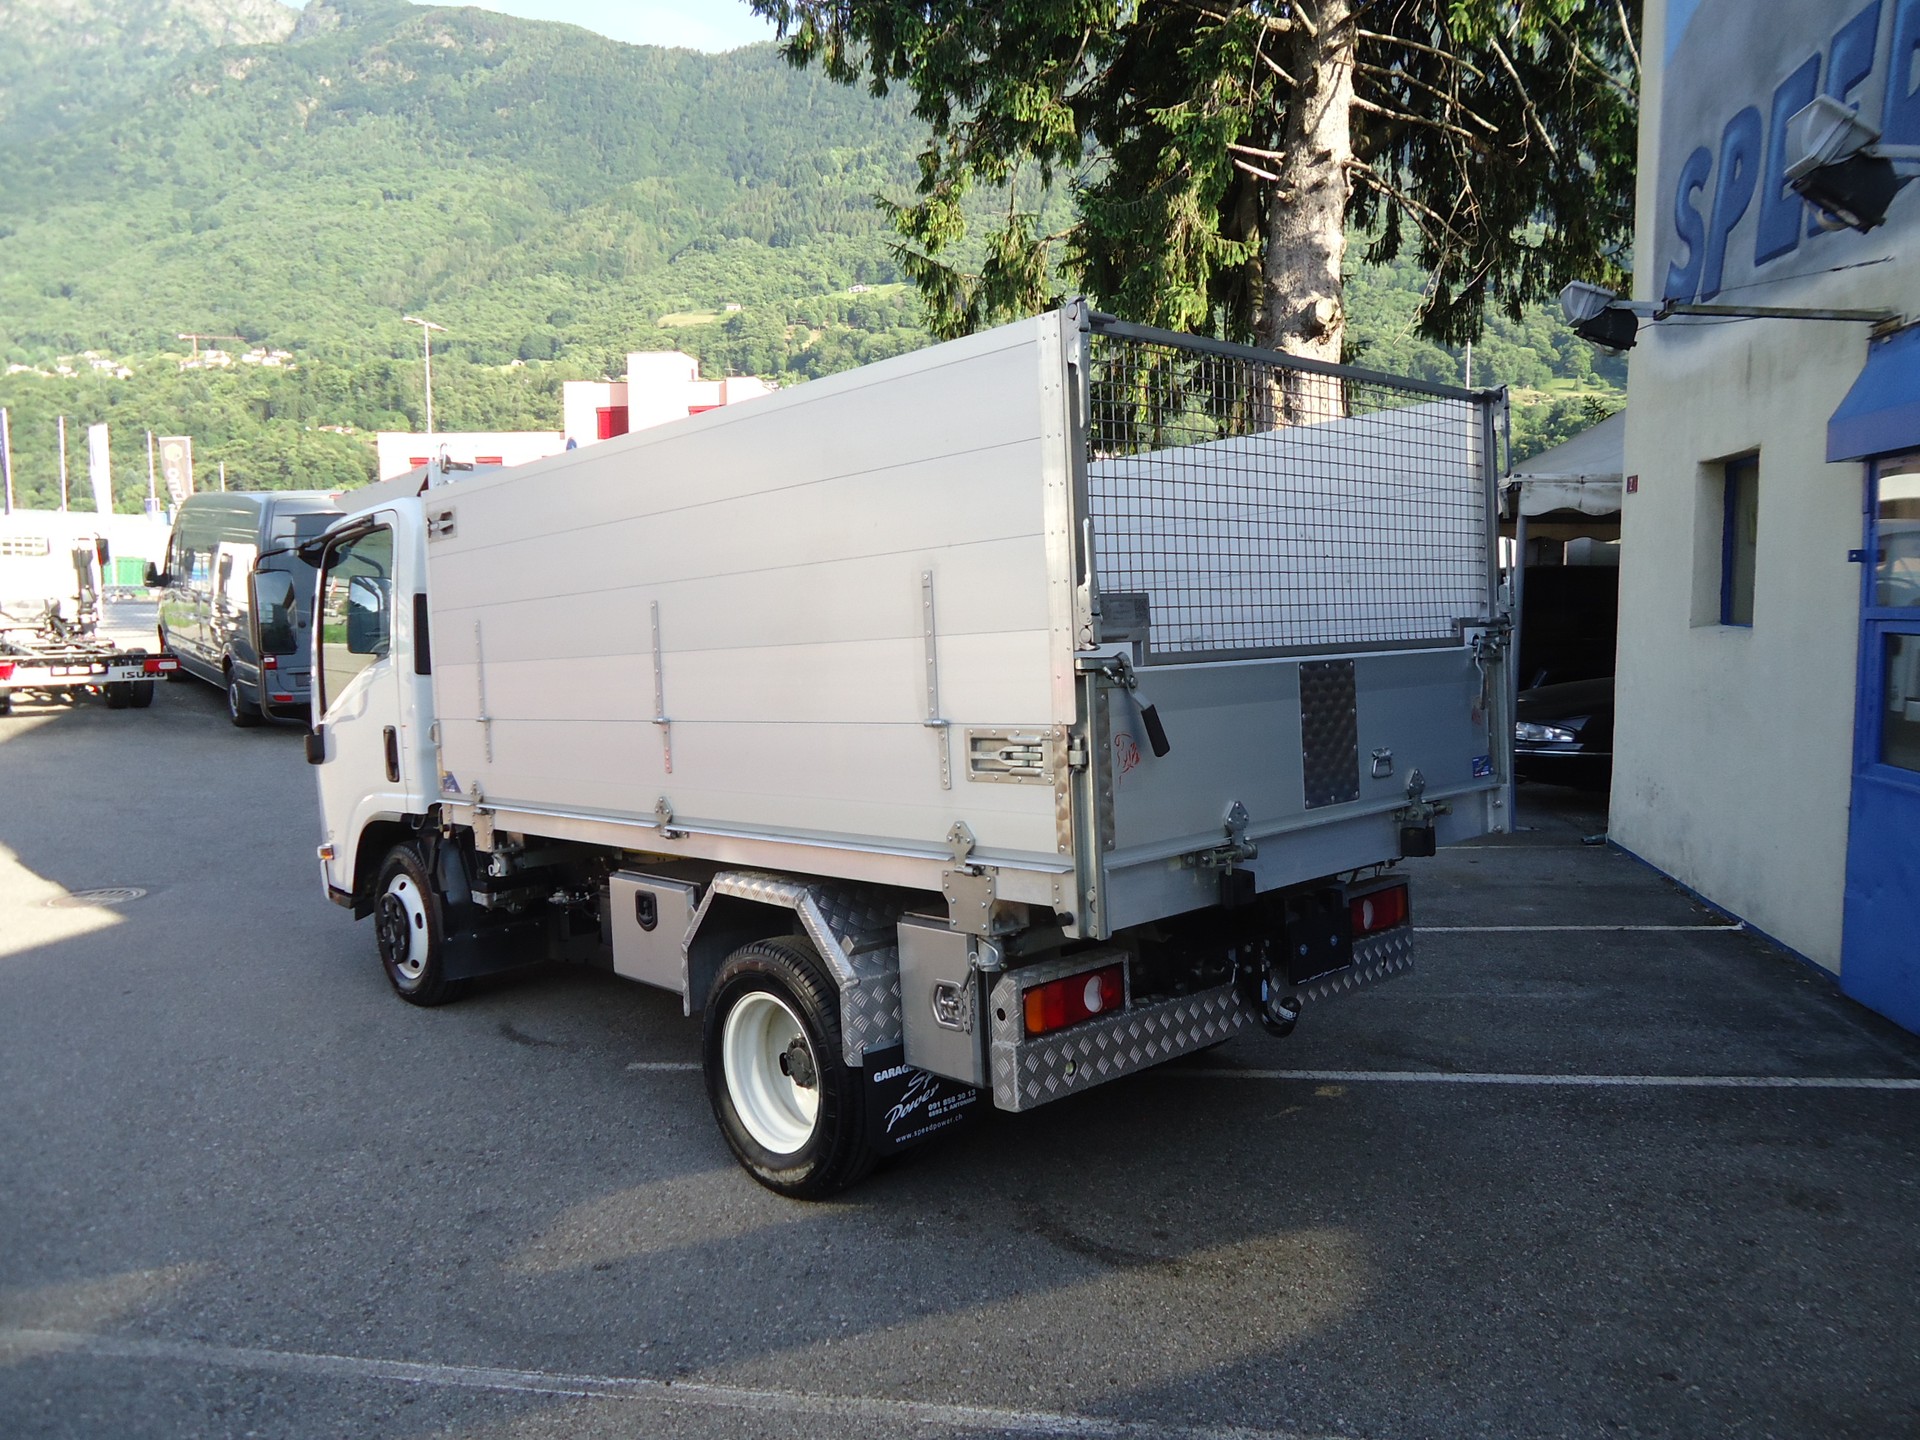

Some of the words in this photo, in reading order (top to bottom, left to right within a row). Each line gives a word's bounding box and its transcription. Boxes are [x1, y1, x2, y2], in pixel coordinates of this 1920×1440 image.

[121, 671, 166, 679] ISUZU
[885, 1083, 940, 1133] Power
[928, 1101, 941, 1111] 091
[957, 1092, 966, 1101] 30
[967, 1088, 976, 1097] 13
[895, 1113, 963, 1143] www.speedpower.ch
